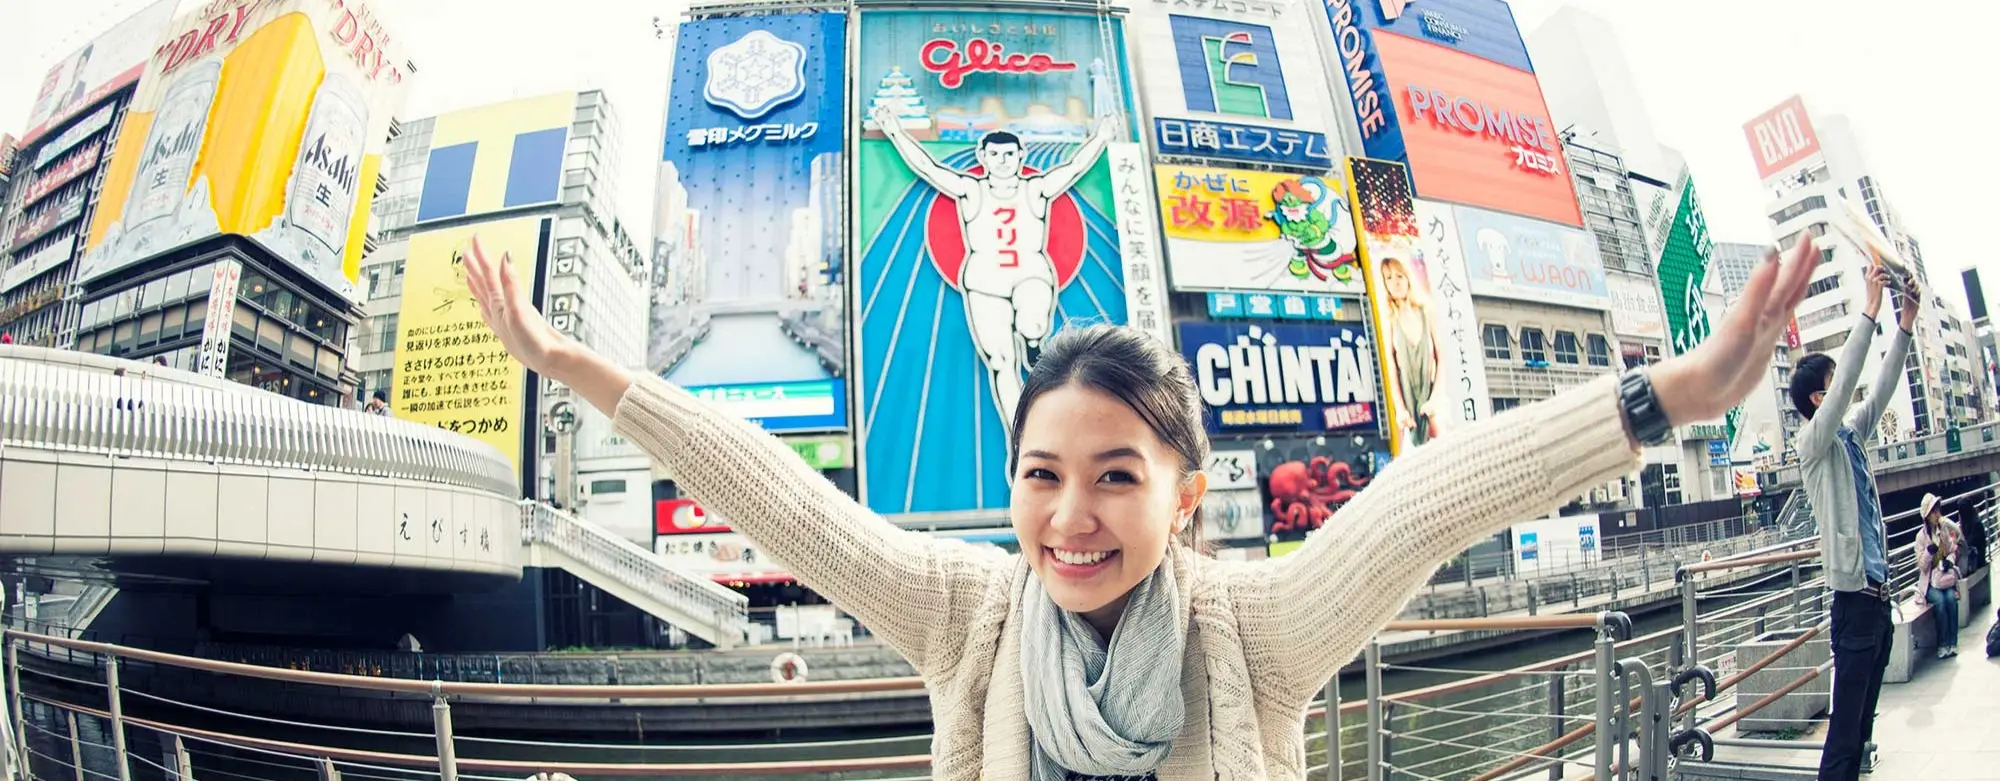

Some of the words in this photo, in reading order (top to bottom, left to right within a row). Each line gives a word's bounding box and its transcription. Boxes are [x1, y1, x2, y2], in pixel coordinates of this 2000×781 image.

[920, 38, 1077, 89] Glico
[1326, 0, 1385, 139] PROMISE
[686, 122, 818, 146] 雪印メグミルク
[1408, 83, 1552, 150] PROMISE
[1160, 120, 1330, 159] 日商エステム
[1754, 106, 1810, 167] B.V.D.
[305, 132, 355, 195] Asahi
[1510, 145, 1560, 175] プロミス
[315, 182, 332, 208] 生
[1173, 171, 1250, 193] かぜに
[1168, 194, 1263, 231] 改源
[1520, 260, 1592, 291] WAON
[201, 338, 213, 376] かに
[215, 339, 226, 379] かに
[1196, 326, 1375, 407] CHINTAI
